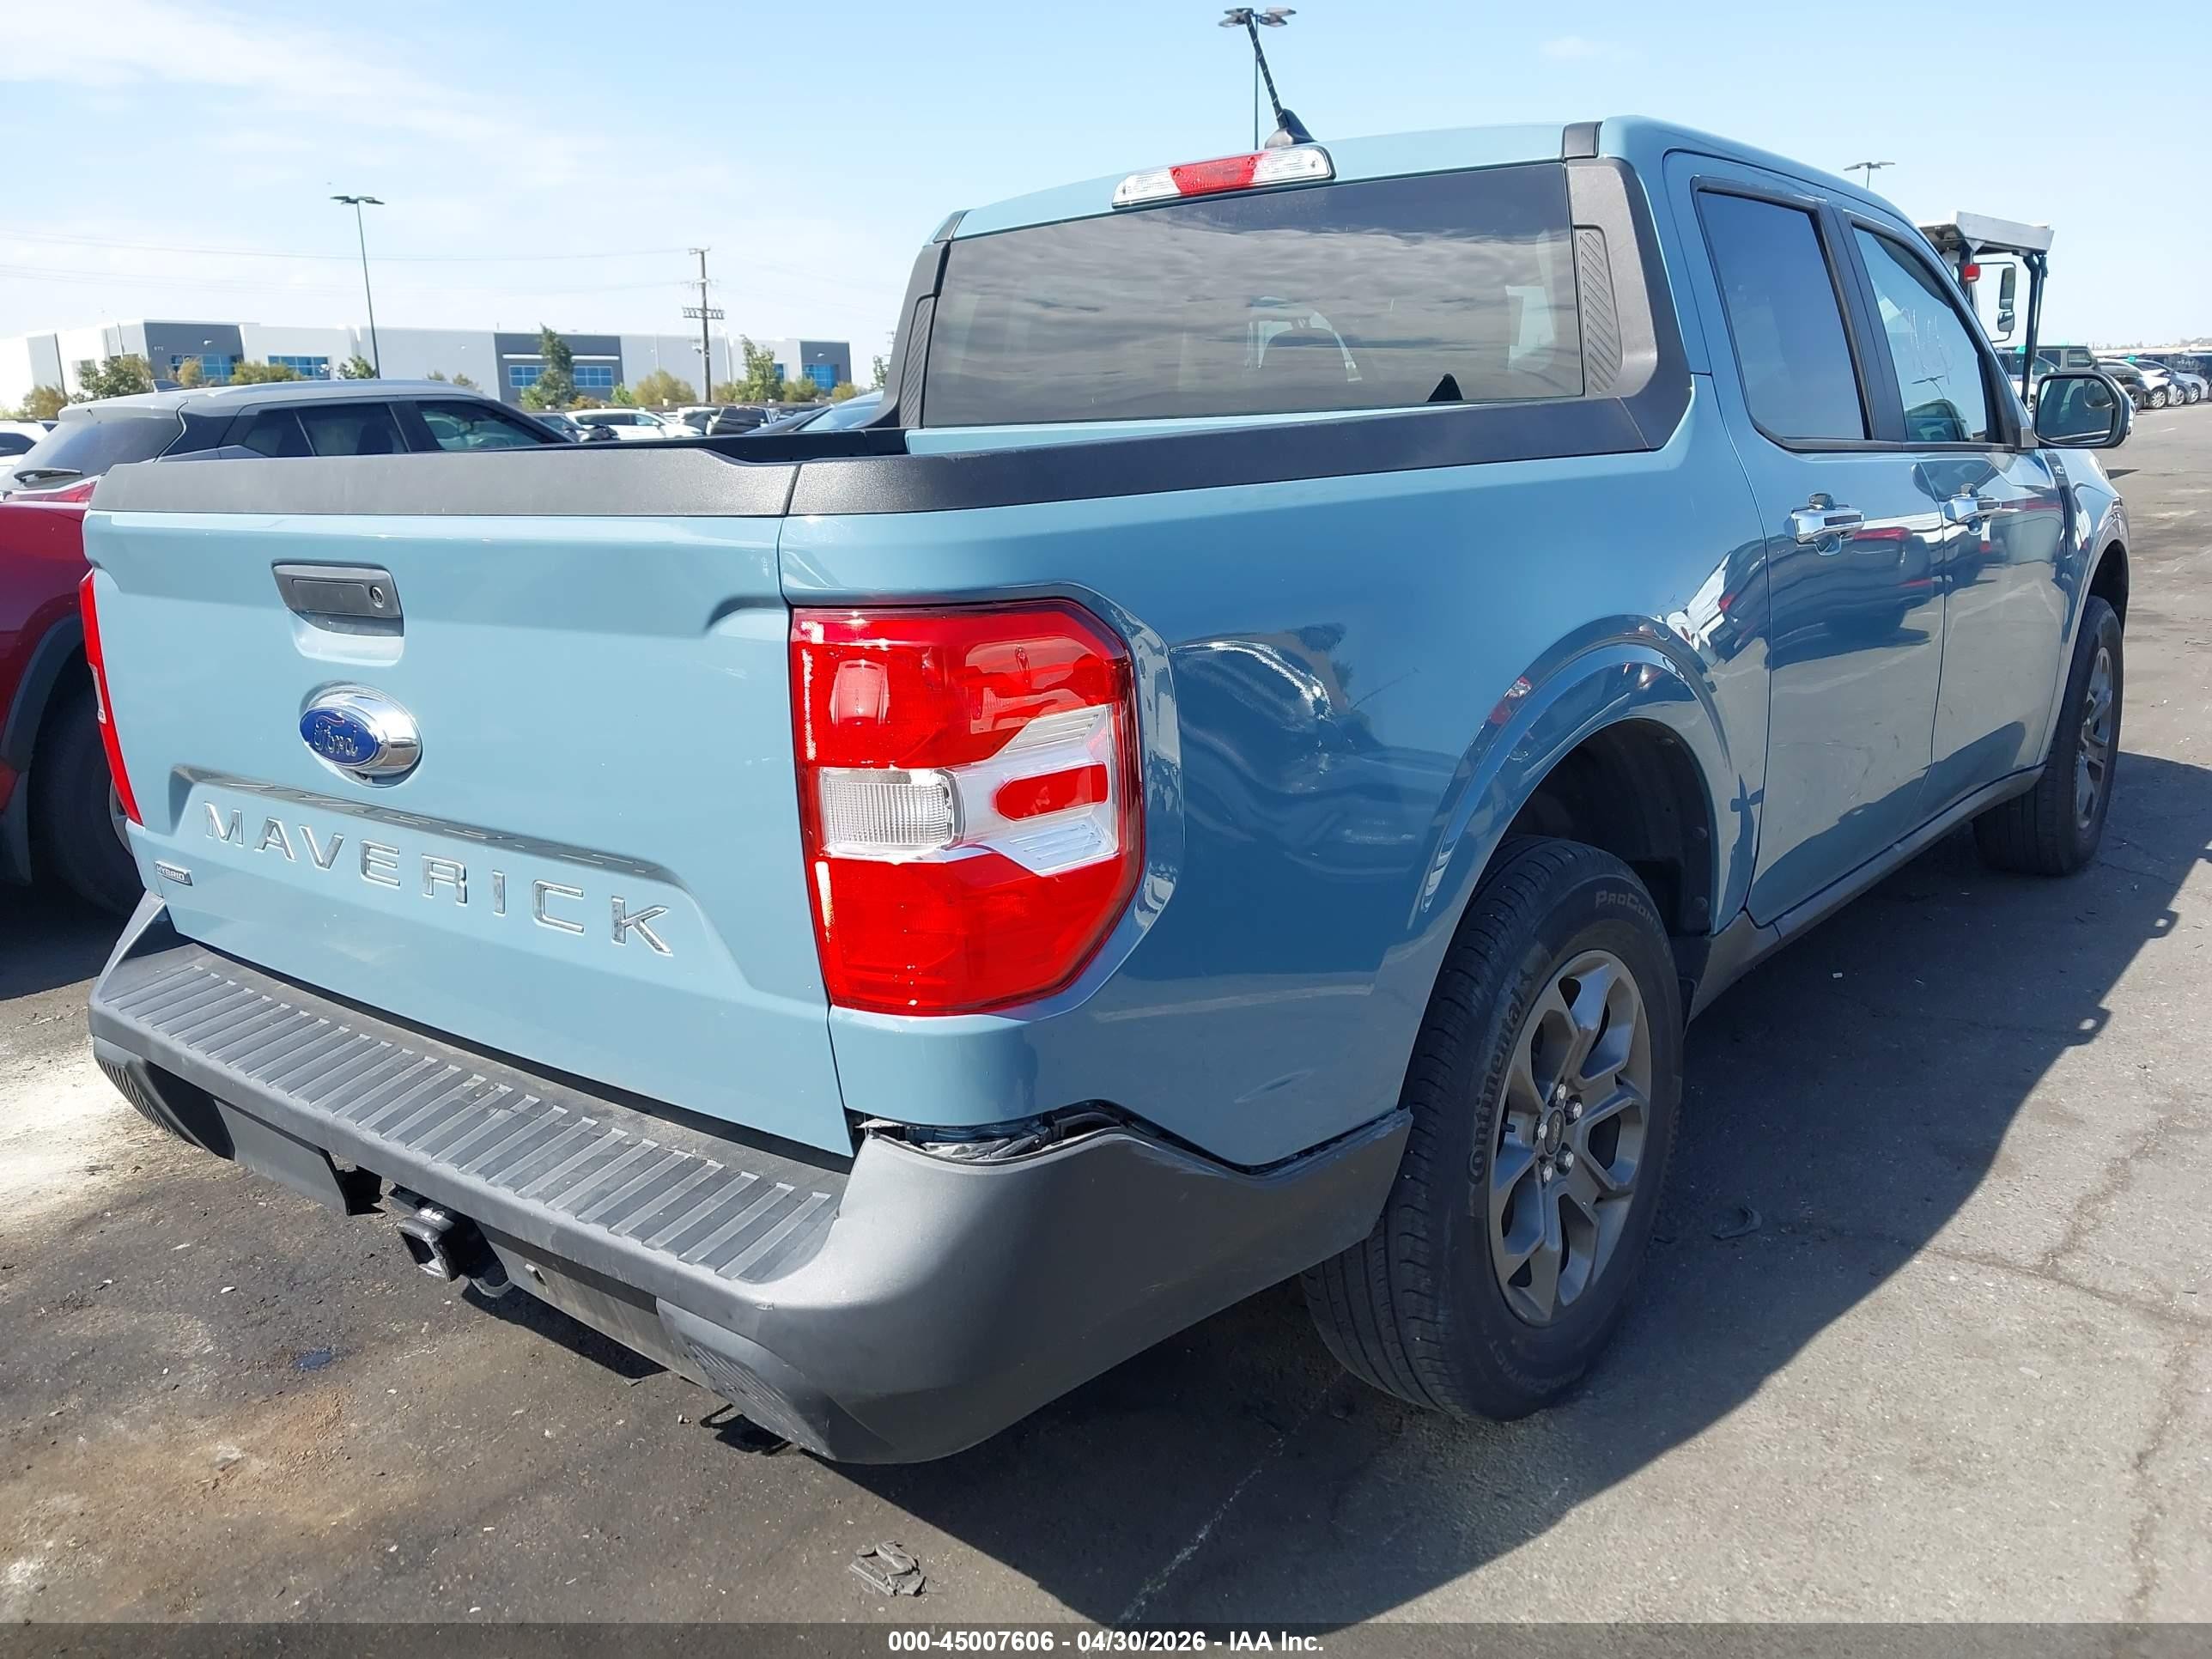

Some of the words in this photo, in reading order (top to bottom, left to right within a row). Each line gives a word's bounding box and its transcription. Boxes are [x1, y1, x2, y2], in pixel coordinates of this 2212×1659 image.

[313, 714, 359, 757] Ford
[156, 865, 185, 881] HYBRID
[204, 801, 673, 957] MAVERICK
